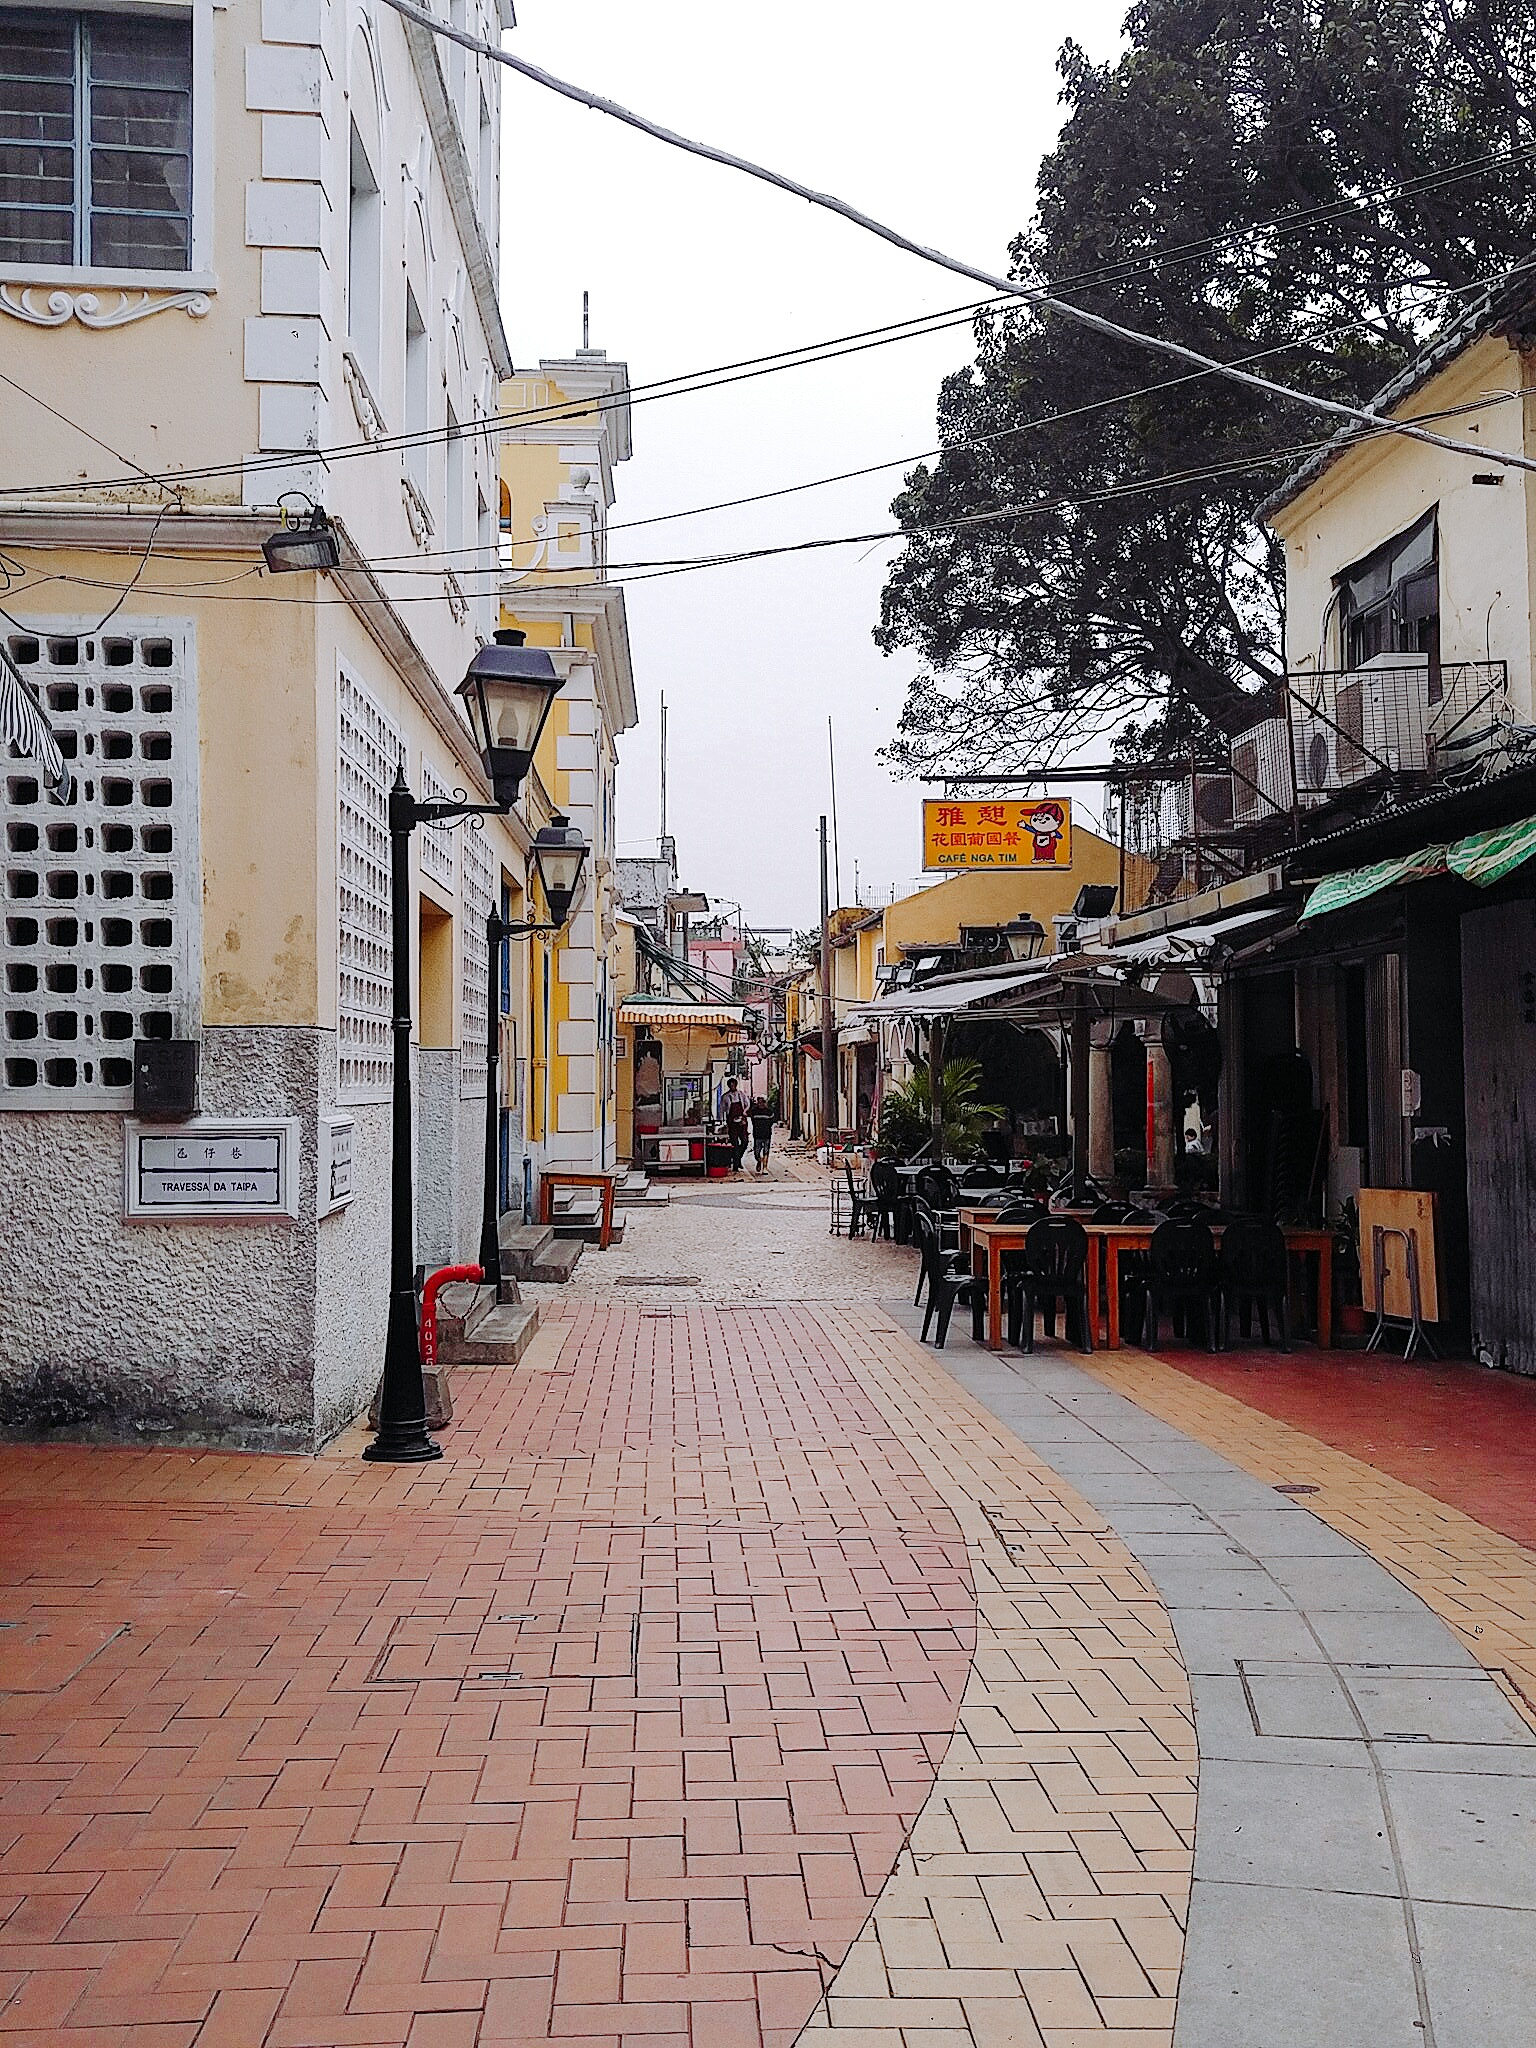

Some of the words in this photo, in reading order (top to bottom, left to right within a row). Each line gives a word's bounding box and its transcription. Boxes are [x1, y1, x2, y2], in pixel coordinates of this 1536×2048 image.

[938, 853, 967, 863] CAFÉ
[971, 854, 994, 862] NGA
[998, 853, 1017, 862] TIM
[162, 1182, 209, 1192] TRAVESSA
[213, 1182, 227, 1192] DA
[231, 1182, 258, 1192] TAIPA
